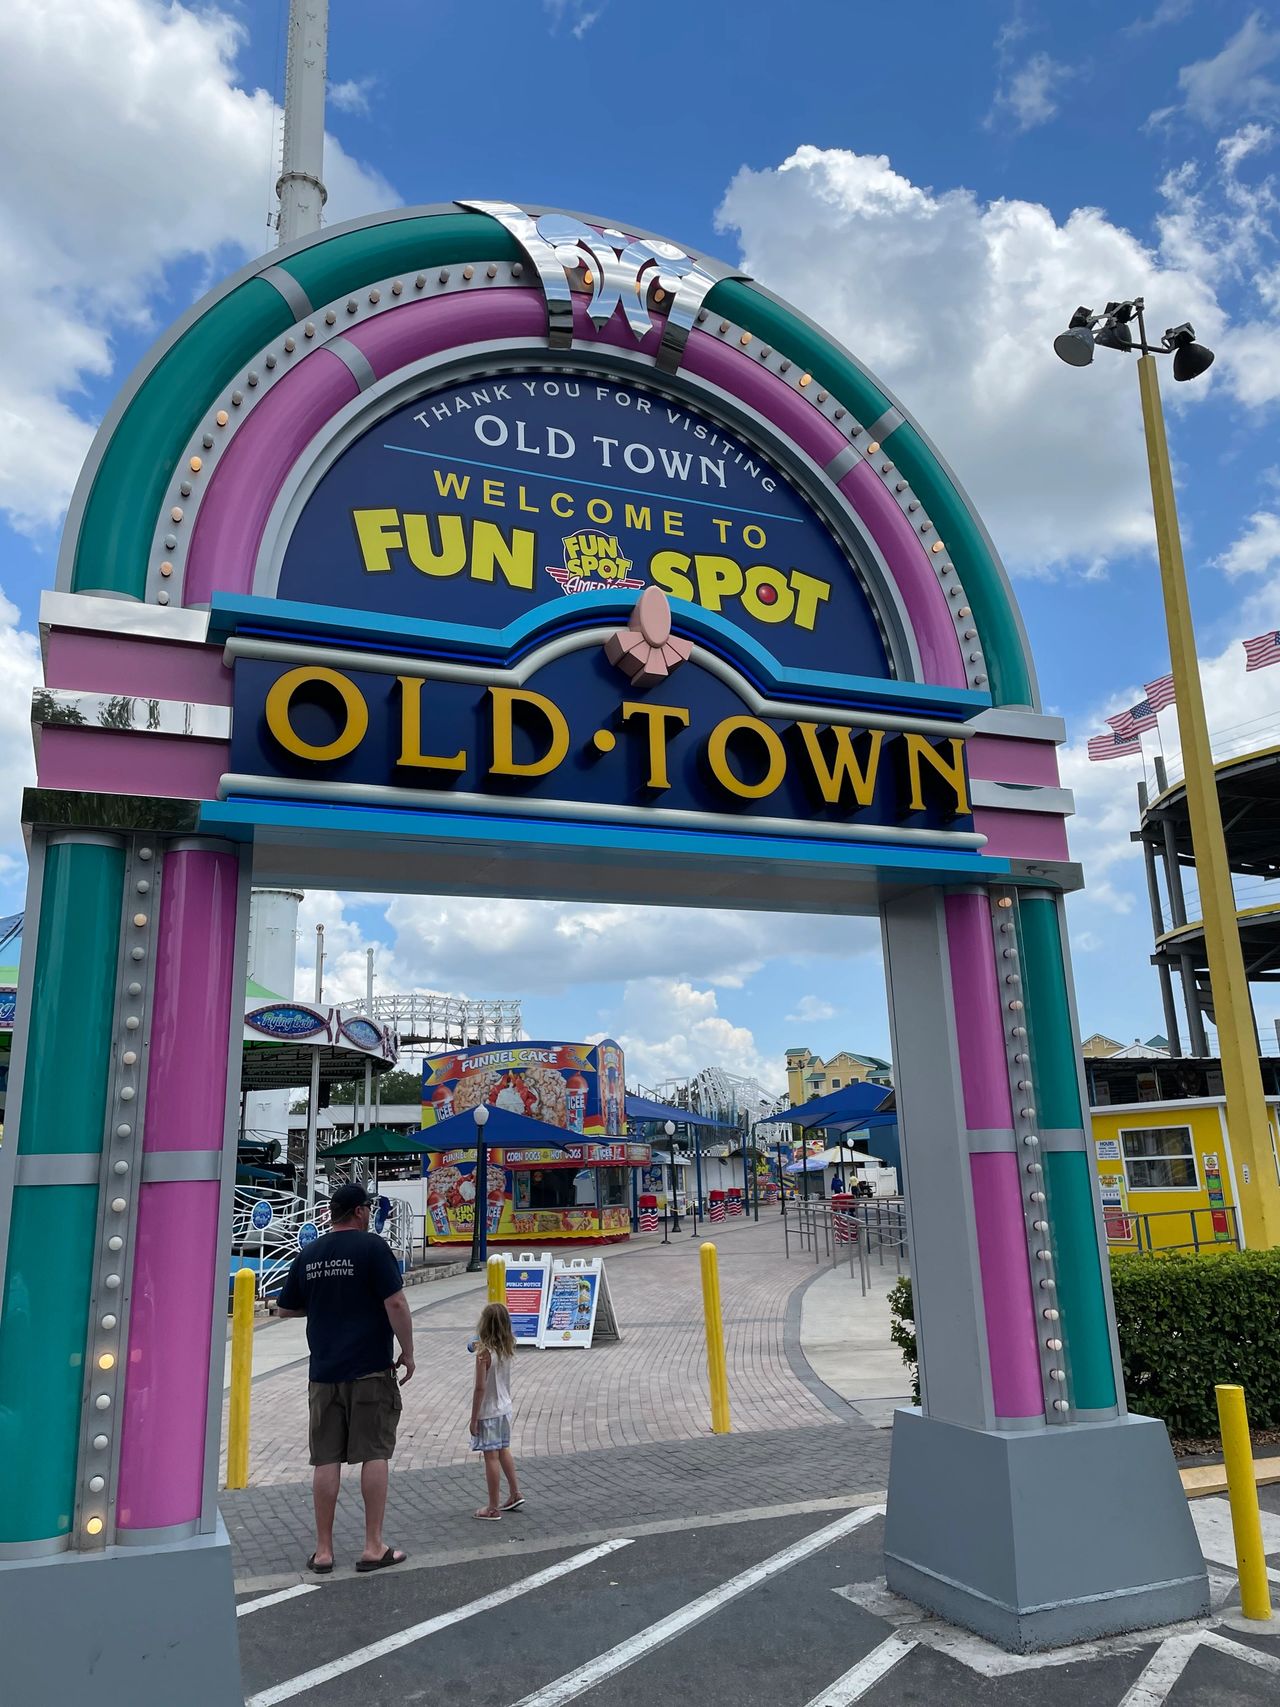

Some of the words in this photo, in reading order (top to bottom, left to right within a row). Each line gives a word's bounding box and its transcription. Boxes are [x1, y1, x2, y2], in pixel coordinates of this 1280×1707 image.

[413, 385, 512, 428] THANK
[522, 381, 580, 397] YOU
[597, 387, 652, 414] FOR
[666, 408, 777, 493] VISITING
[474, 414, 576, 459] OLD
[593, 435, 727, 488] TOWN
[434, 470, 684, 537] WELCOME
[713, 519, 767, 549] TO
[564, 534, 618, 558] FUN
[353, 508, 536, 590] FUN
[650, 551, 831, 631] SPOT
[567, 555, 631, 579] SPOT
[265, 666, 570, 776] OLD
[621, 701, 972, 815] TOWN
[461, 1051, 516, 1073] FUNNEL
[518, 1050, 558, 1065] CAKE
[436, 1102, 454, 1122] ICEE
[567, 1094, 585, 1110] ICEE
[506, 1151, 523, 1162] CORN
[431, 1206, 447, 1220] ICEE
[457, 1204, 473, 1215] FUN
[305, 1261, 323, 1272] BUY
[324, 1259, 354, 1269] LOCAL
[306, 1271, 323, 1281] BUY
[324, 1268, 354, 1277] NATIVE
